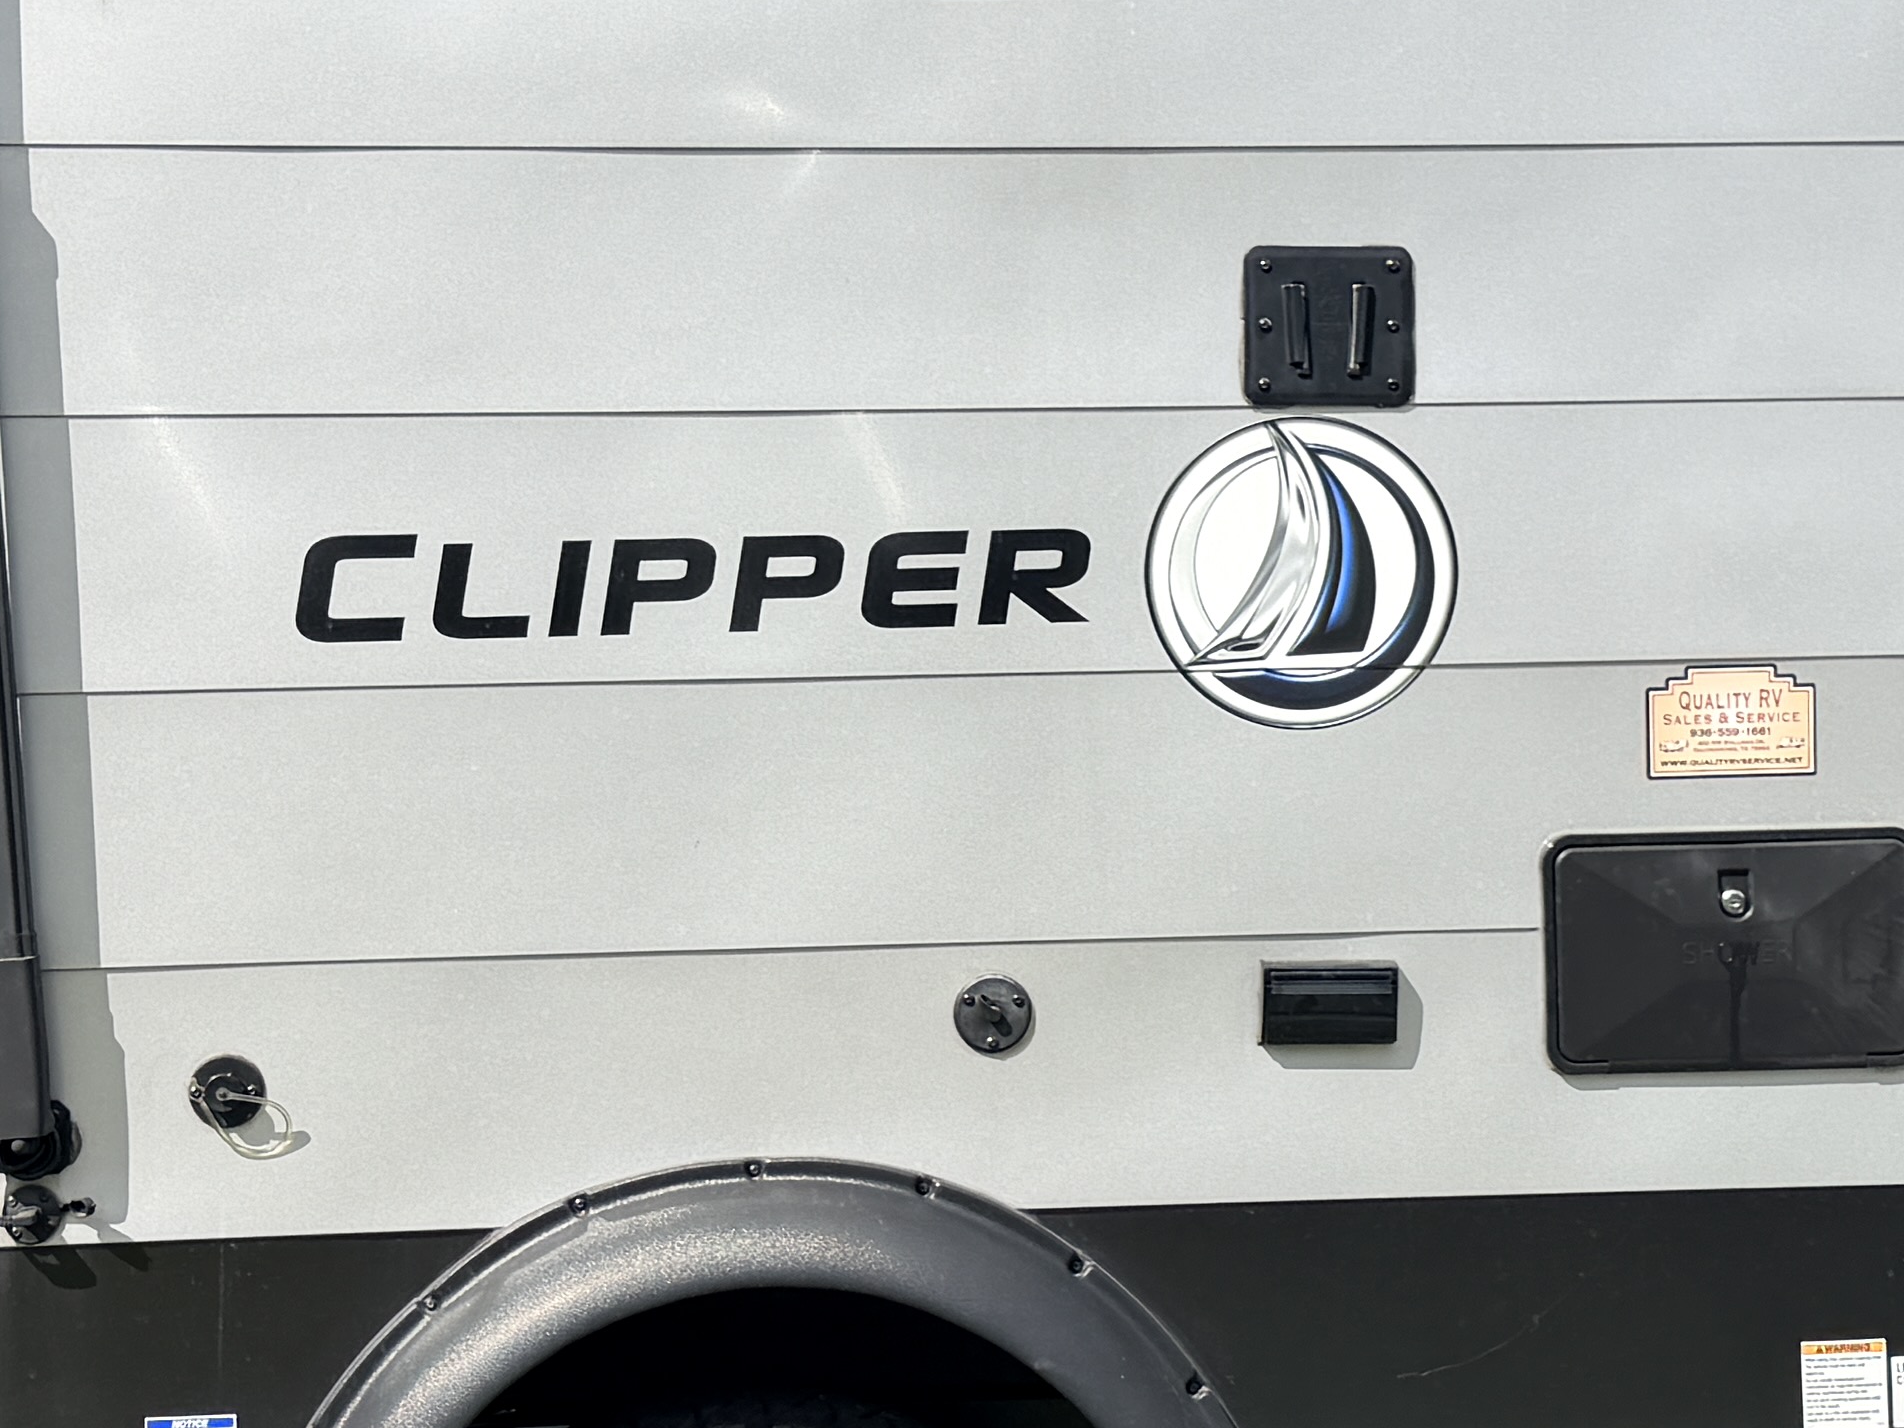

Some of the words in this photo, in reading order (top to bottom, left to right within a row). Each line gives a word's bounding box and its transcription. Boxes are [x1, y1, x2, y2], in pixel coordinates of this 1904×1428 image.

[295, 528, 1092, 643] CLIPPER
[1678, 690, 1752, 712] QUALITY
[1758, 688, 1783, 708] RV
[1662, 713, 1713, 726] SALES
[1718, 712, 1729, 724] &
[1735, 711, 1802, 724] SERVICE
